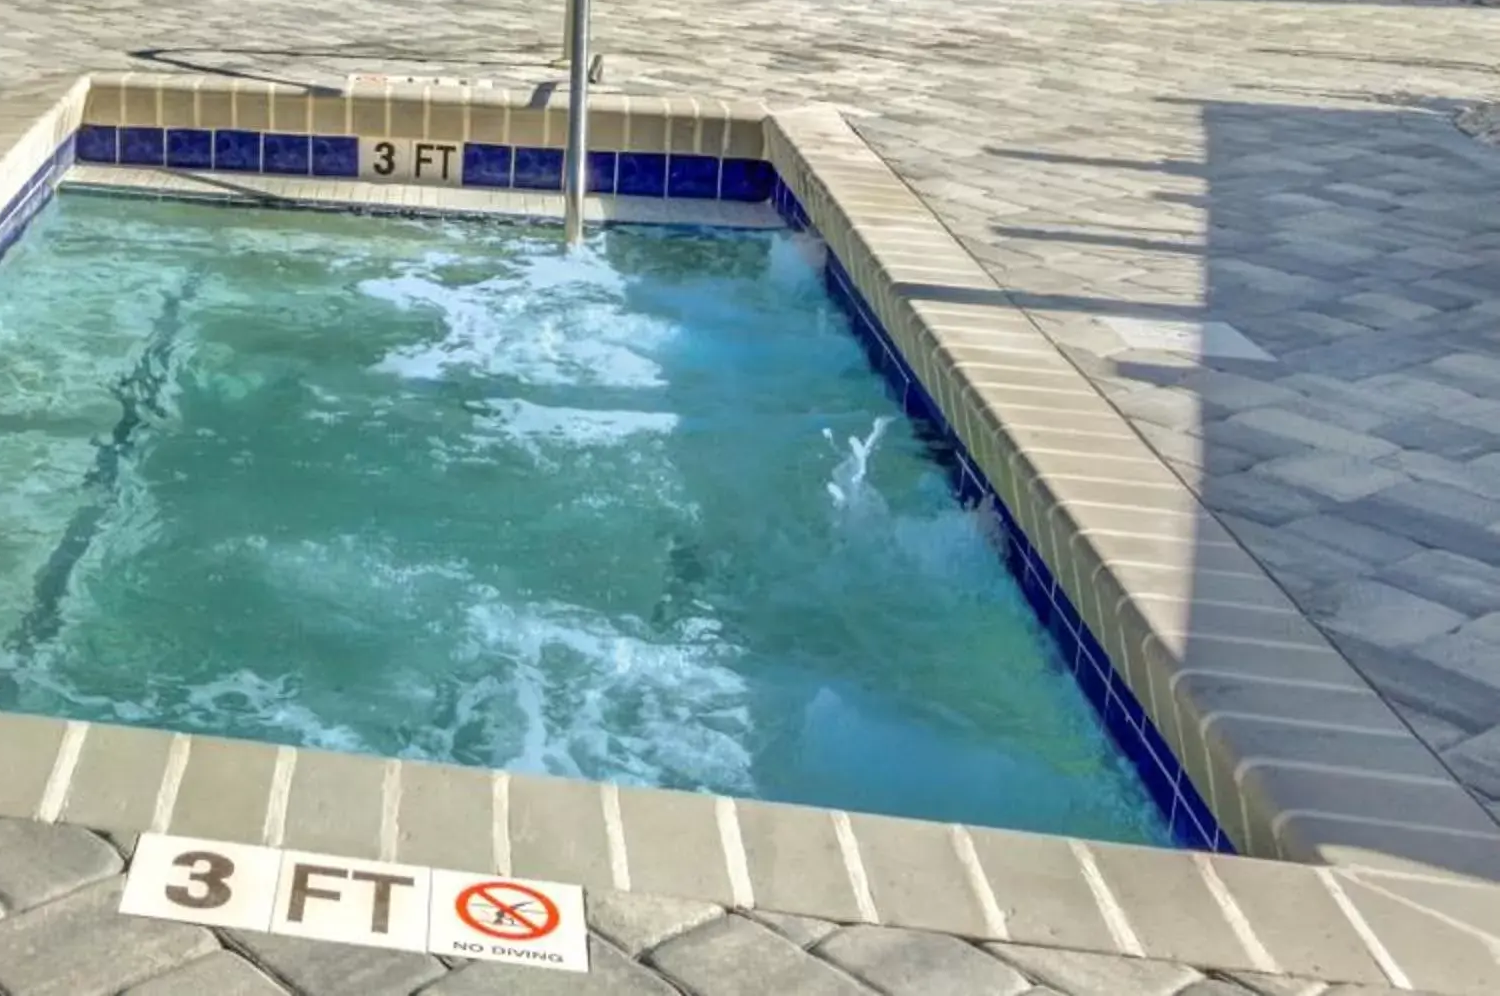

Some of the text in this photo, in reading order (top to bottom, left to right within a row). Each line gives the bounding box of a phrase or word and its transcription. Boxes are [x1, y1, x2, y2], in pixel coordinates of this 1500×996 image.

[373, 142, 456, 179] 3 FT
[164, 850, 416, 935] 3 FT
[453, 941, 564, 963] NO DIVING
